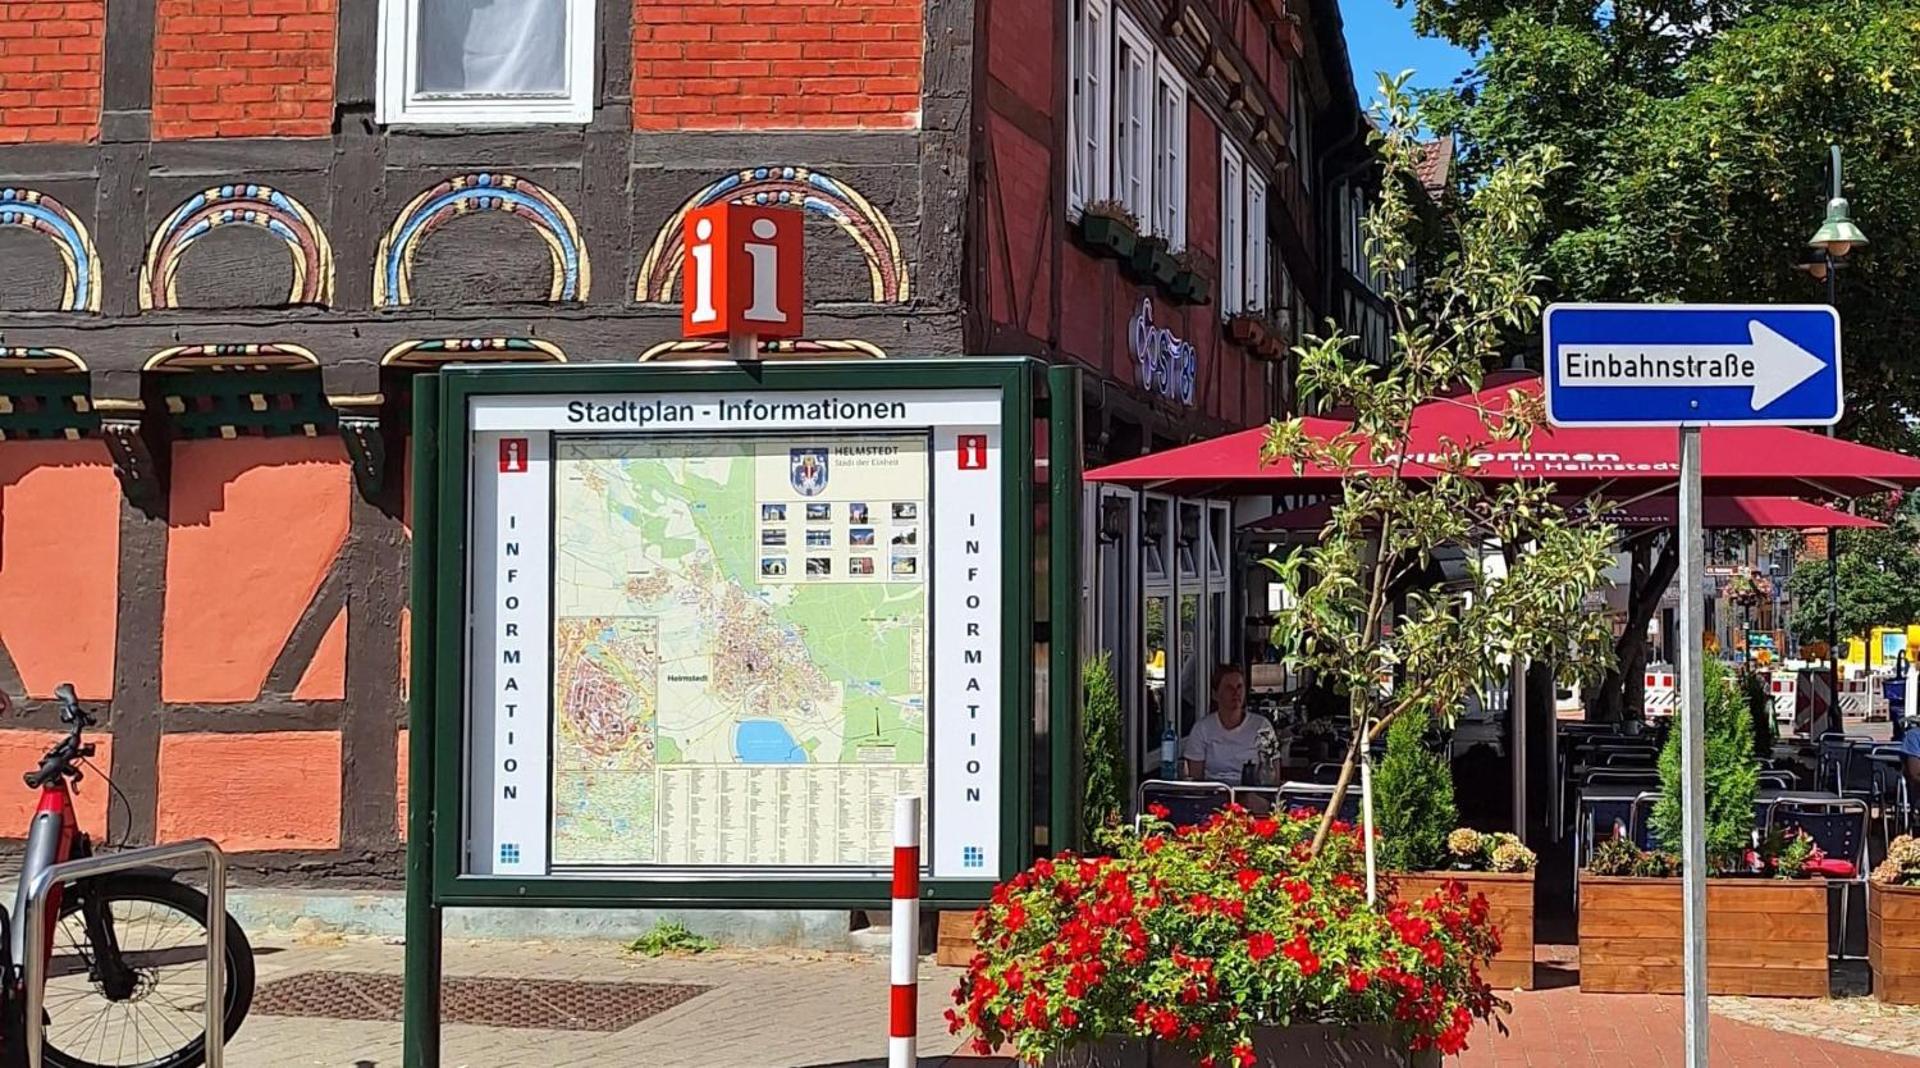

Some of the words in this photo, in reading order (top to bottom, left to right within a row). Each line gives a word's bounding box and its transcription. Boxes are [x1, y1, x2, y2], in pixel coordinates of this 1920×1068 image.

[1566, 353, 1755, 378] Einbahnstraße
[567, 400, 694, 427] Stadtplan
[718, 397, 906, 421] Informationen
[834, 446, 899, 455] HELMSTEDT
[1513, 462, 1536, 471] in
[1544, 461, 1680, 471] Helmstedt
[503, 516, 520, 799] INFORMATION
[964, 513, 982, 802] INFORMATION
